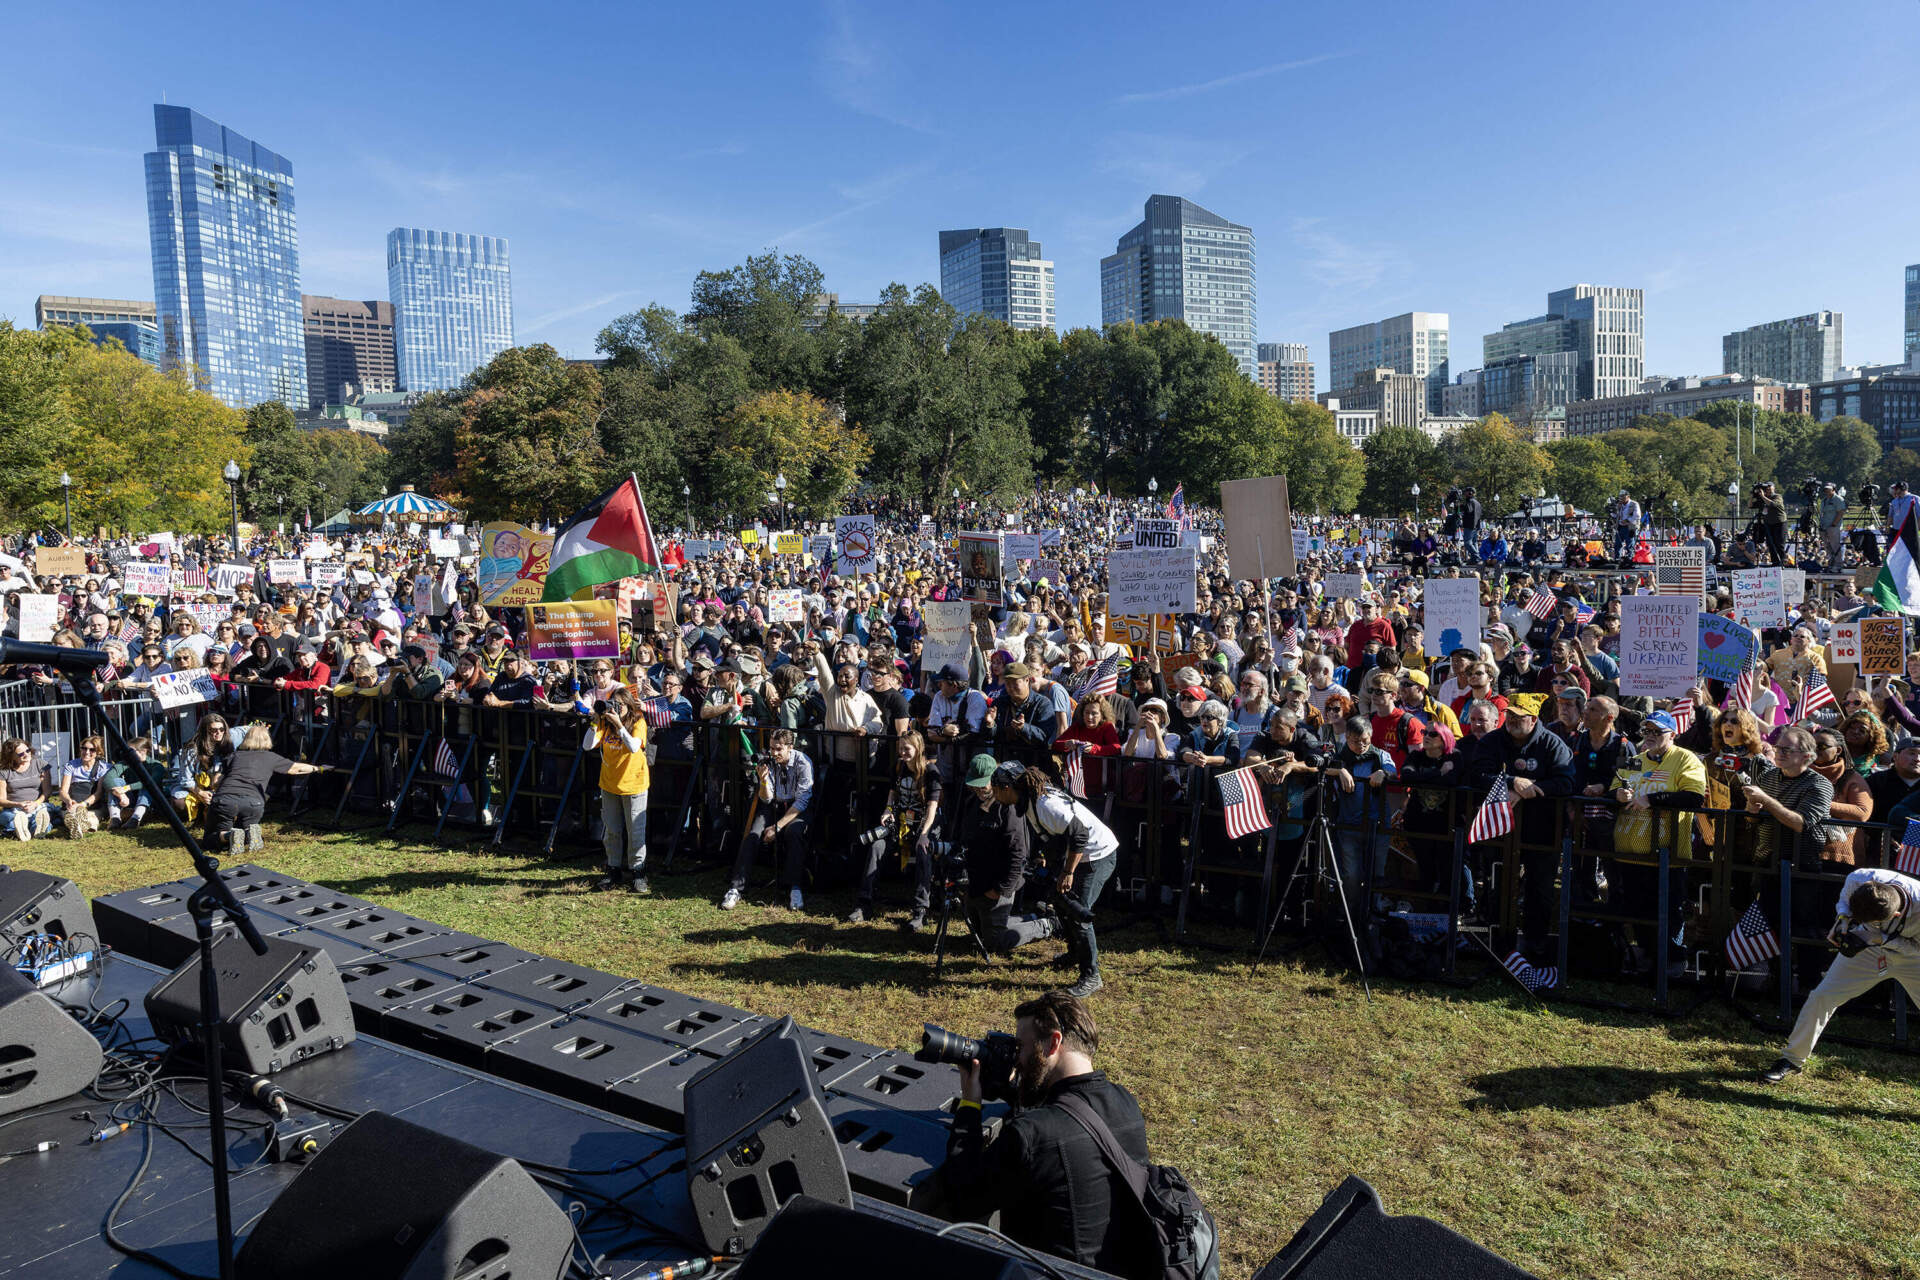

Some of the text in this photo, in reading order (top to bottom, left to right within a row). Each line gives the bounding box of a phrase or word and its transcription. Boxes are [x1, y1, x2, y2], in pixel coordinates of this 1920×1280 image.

[1137, 520, 1179, 531] THE PEOPLE
[780, 535, 800, 543] NASW
[1136, 531, 1178, 548] UNITED
[110, 548, 129, 559] HATE
[535, 559, 549, 571] ST
[1120, 560, 1146, 568] WILL
[1150, 559, 1162, 567] NOT
[1733, 571, 1755, 580] Soros
[964, 577, 976, 587] FU
[1120, 582, 1185, 591] WHO DID NOT
[1737, 580, 1761, 590] Send
[502, 597, 526, 605] CARE
[1123, 595, 1149, 604] SPEAK
[1627, 604, 1692, 615] GUARANTEED
[566, 611, 594, 620] tRump
[581, 620, 610, 628] fascist
[1699, 618, 1720, 630] ave
[1864, 622, 1883, 633] No
[552, 630, 593, 639] pedophile
[1130, 625, 1171, 647] DE
[1638, 627, 1680, 638] BITCH
[1837, 630, 1853, 638] NO
[538, 640, 582, 649] protection
[1863, 634, 1901, 645] Kings
[1633, 640, 1688, 652] SCREWS
[1864, 645, 1900, 656] Since
[1628, 653, 1689, 665] UKRAINE
[1865, 656, 1900, 668] 1776
[173, 684, 189, 696] NO
